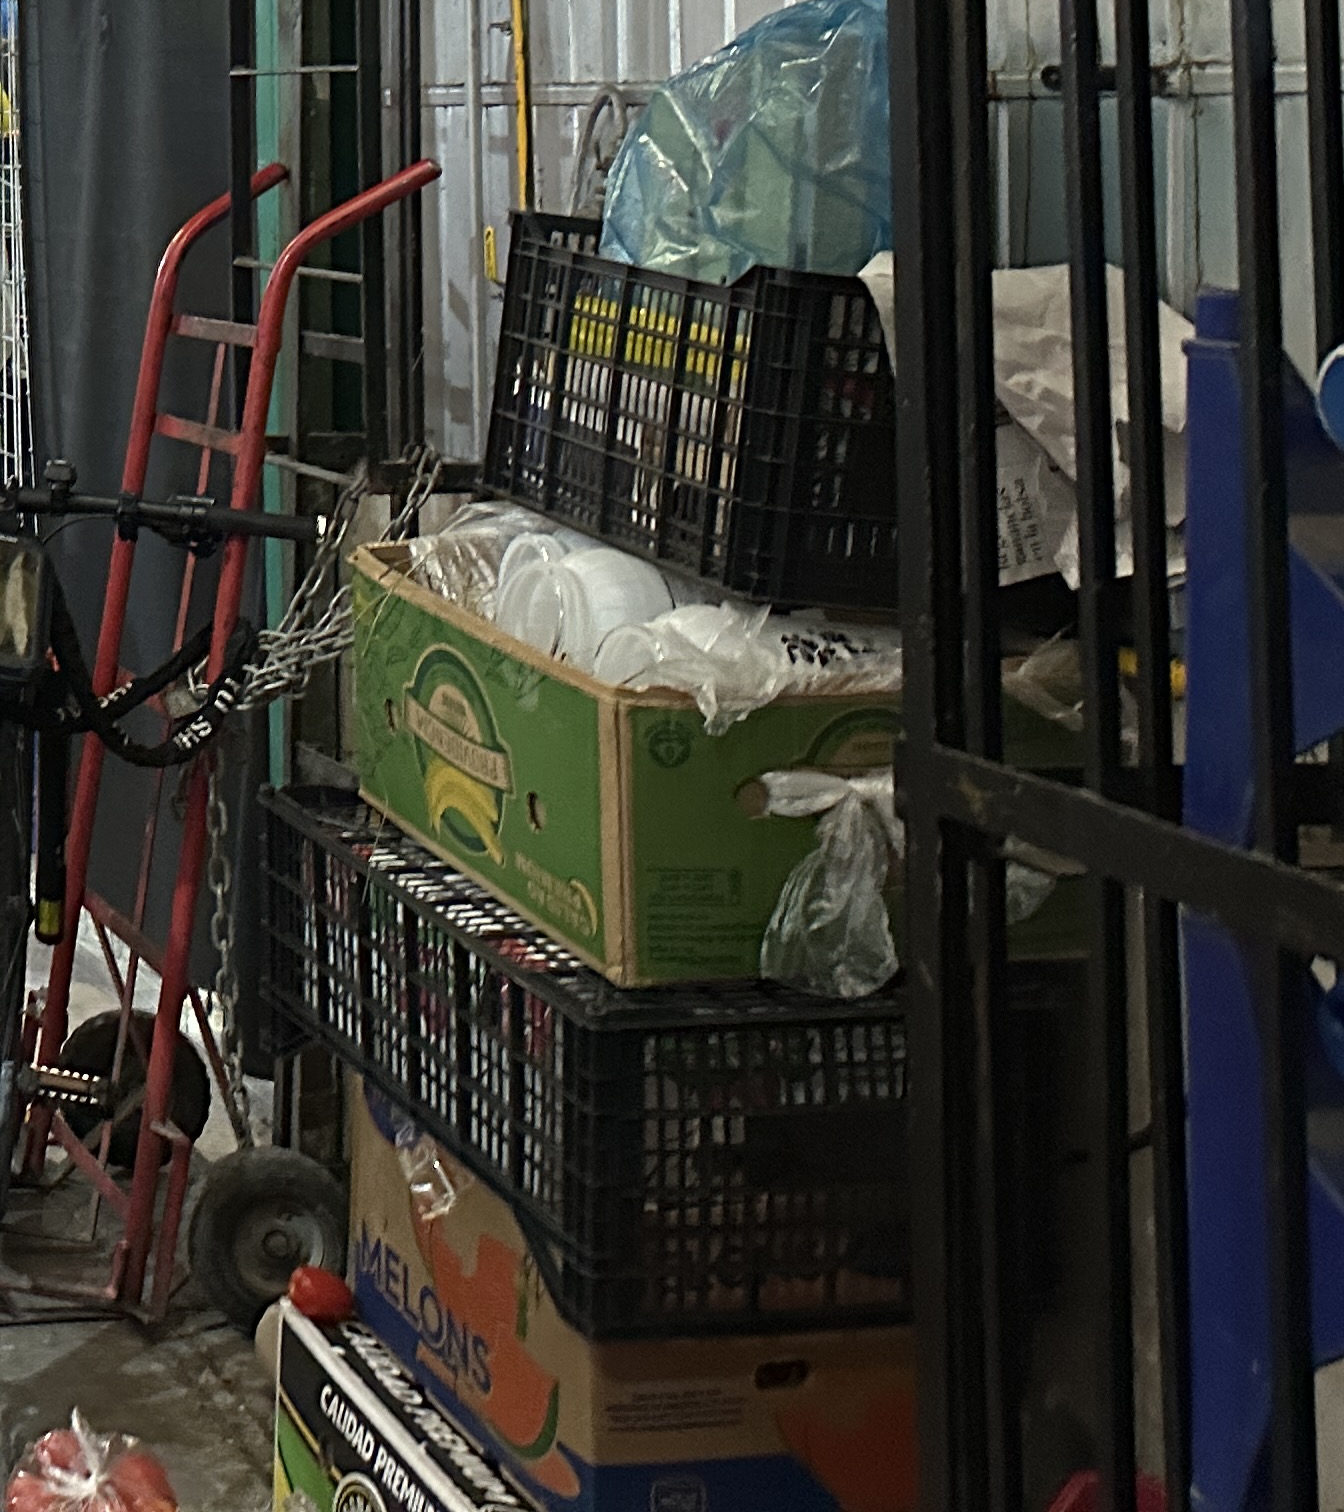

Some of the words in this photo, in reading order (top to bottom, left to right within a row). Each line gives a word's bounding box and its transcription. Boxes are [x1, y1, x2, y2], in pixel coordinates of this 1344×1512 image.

[355, 1219, 492, 1395] MELONS
[320, 1384, 375, 1463] CALIDAD
[373, 1445, 439, 1512] PREMI
